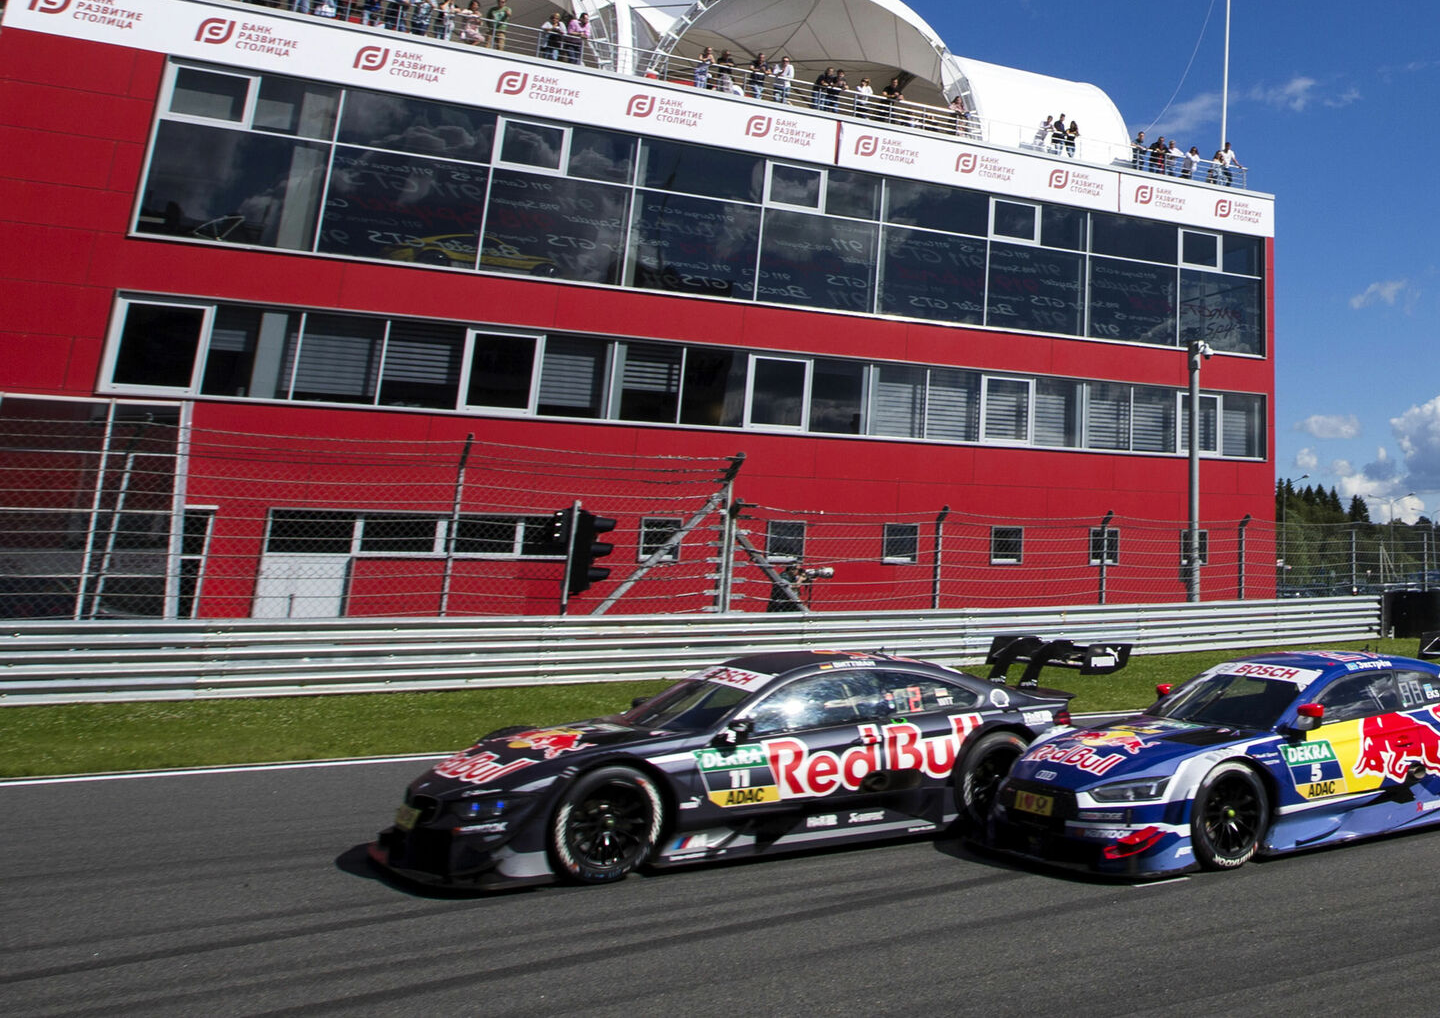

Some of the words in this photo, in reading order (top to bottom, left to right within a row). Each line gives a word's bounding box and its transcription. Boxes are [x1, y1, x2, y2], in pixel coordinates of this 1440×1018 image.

[76, 2, 143, 22] РАЗВИТИЕ
[73, 12, 132, 29] СТОЛИЦА
[241, 22, 272, 34] БАНК
[238, 32, 298, 48] РАЗВИТИЕ
[235, 41, 289, 57] СТОЛИЦА
[395, 50, 423, 61] БАНК
[392, 59, 446, 74] РАЗВИТИЕ
[390, 68, 439, 82] СТОЛИЦА
[533, 75, 559, 85] БАНК
[531, 83, 580, 98] РАЗВИТИЕ
[529, 92, 574, 105] СТОЛИЦА
[660, 98, 683, 108] БАНК
[658, 106, 704, 120] РАЗВИТИЕ
[656, 114, 697, 127] СТОЛИЦА
[776, 118, 798, 128] БАНК
[774, 126, 816, 139] РАЗВИТИЕ
[772, 134, 810, 146] СТОЛИЦА
[882, 138, 902, 147] БАНК
[881, 146, 920, 158] РАЗВИТИЕ
[880, 153, 915, 164] СТОЛИЦА
[980, 156, 1000, 164] БАНК
[980, 164, 1015, 175] РАЗВИТИЕ
[978, 170, 1012, 182] СТОЛИЦА
[1072, 172, 1090, 180] БАНК
[1071, 179, 1104, 190] РАЗВИТИЕ
[1070, 186, 1100, 196] СТОЛИЦА
[1156, 194, 1186, 204] РАЗВИТИЕ
[1154, 201, 1182, 212] СТОЛИЦА
[1232, 214, 1260, 224] СТОЛИЦА
[1234, 208, 1262, 218] РАЗВИТИЕ
[1234, 664, 1300, 679] BOSCH
[1426, 689, 1440, 700] EKS
[1287, 744, 1331, 762] DEKRA
[765, 725, 879, 796] Red
[1021, 744, 1081, 762] Red
[1061, 746, 1127, 776] Bull
[1310, 763, 1322, 782] 5
[729, 770, 750, 788] 11
[1308, 781, 1336, 798] ADAC
[727, 788, 764, 805] ADAC
